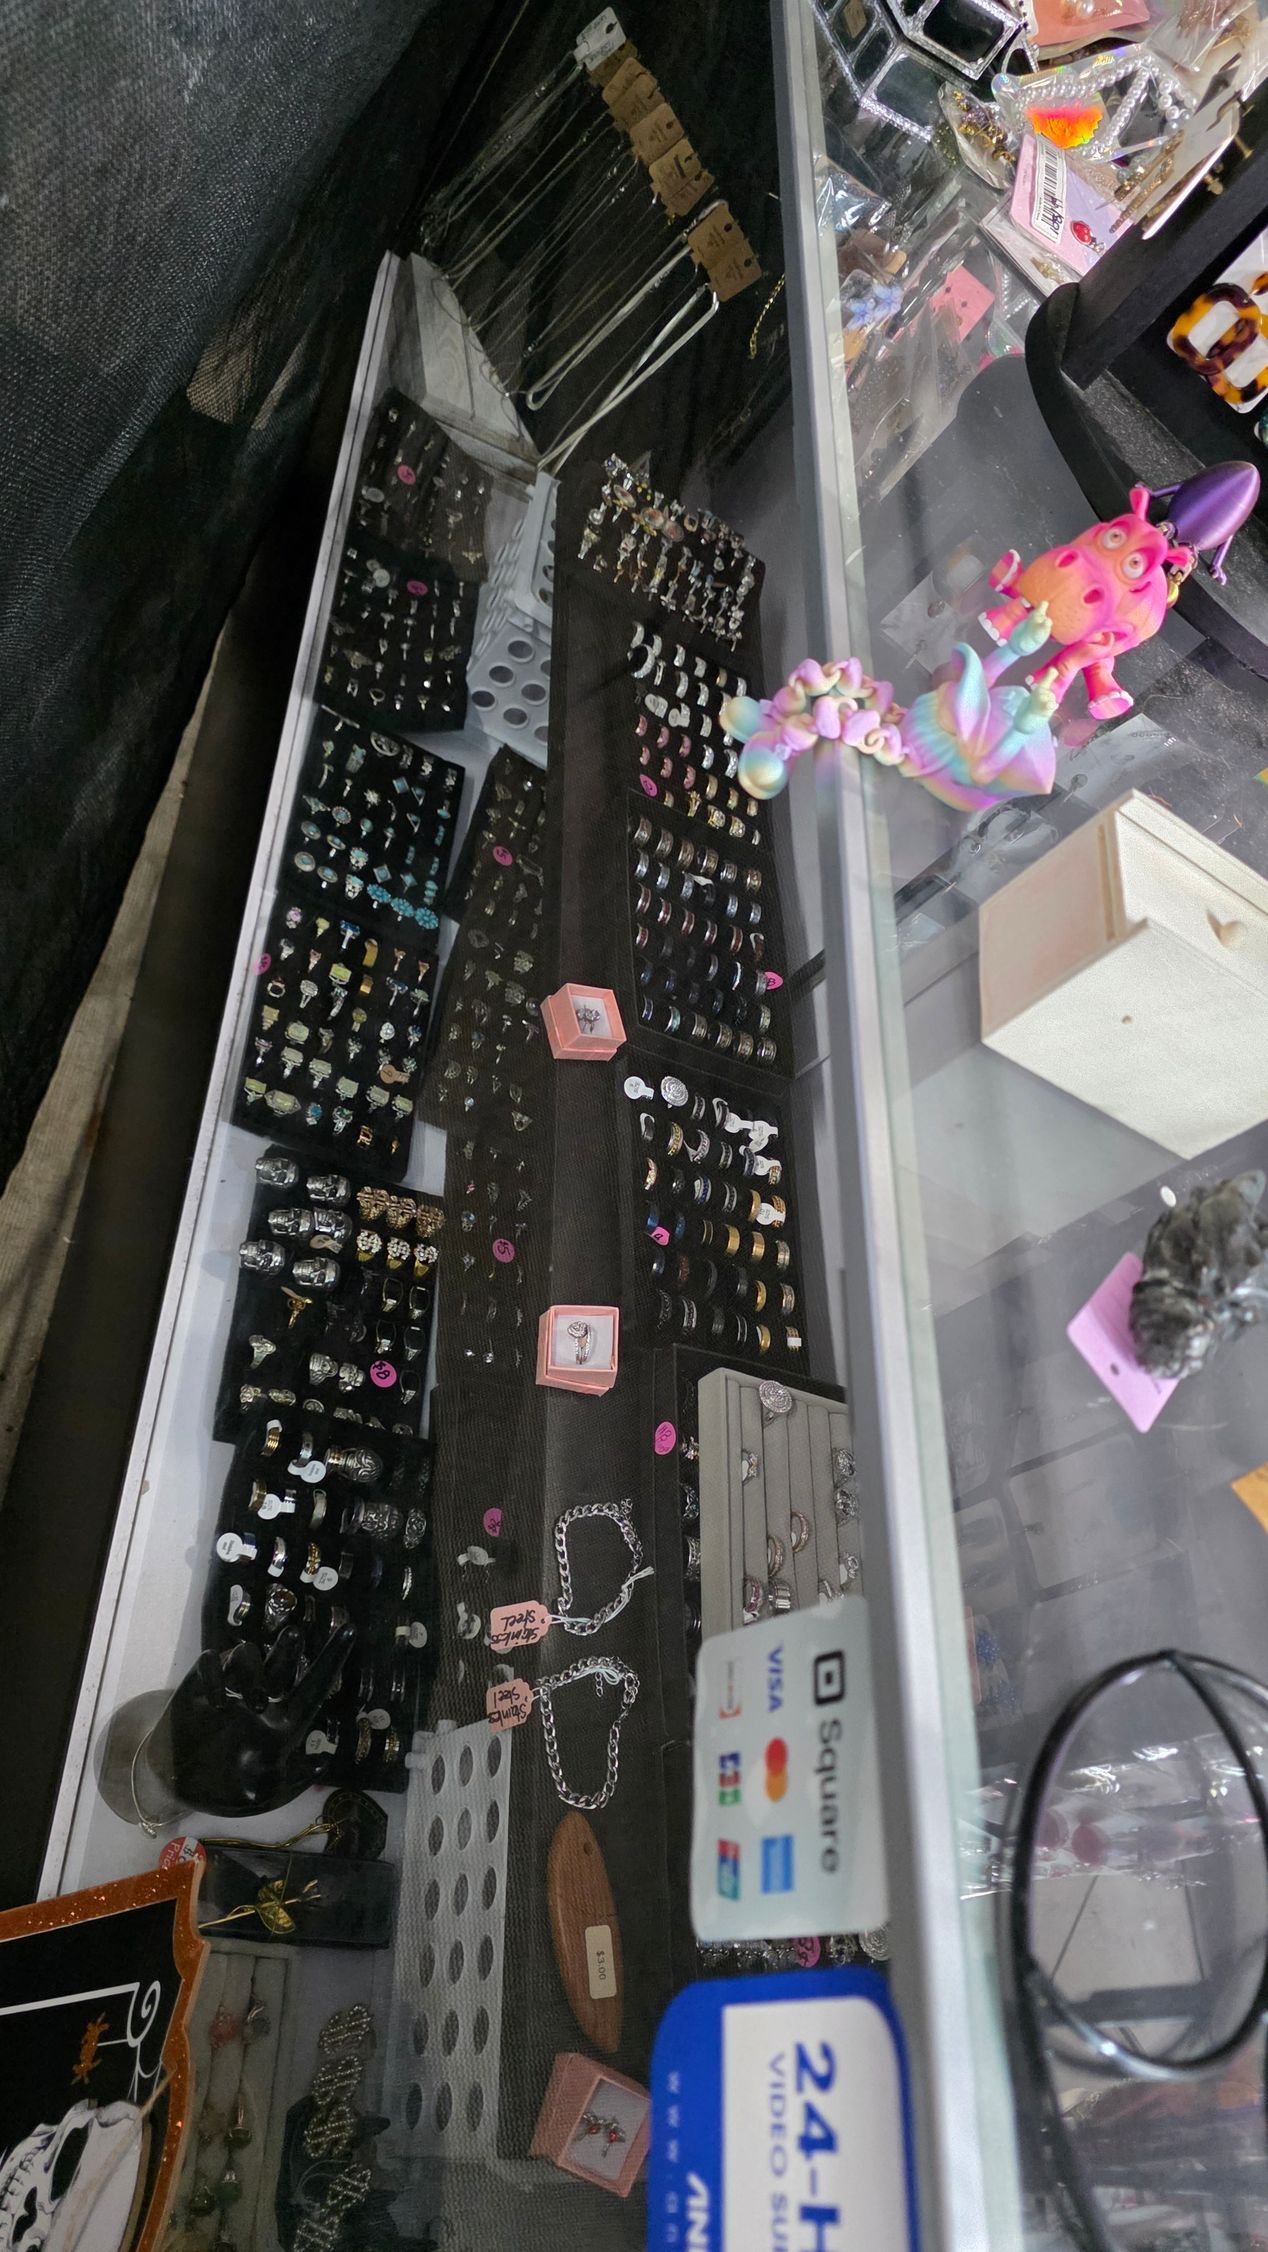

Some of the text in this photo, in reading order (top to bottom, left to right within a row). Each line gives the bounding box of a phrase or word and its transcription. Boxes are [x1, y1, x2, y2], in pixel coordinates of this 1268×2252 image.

[373, 1361, 391, 1380] $8
[766, 1643, 784, 1713] VISA
[816, 1718, 844, 1873] Square
[595, 1950, 607, 1981] $3.00
[769, 2052, 789, 2179] VIDEO
[686, 2170, 711, 2252] AN
